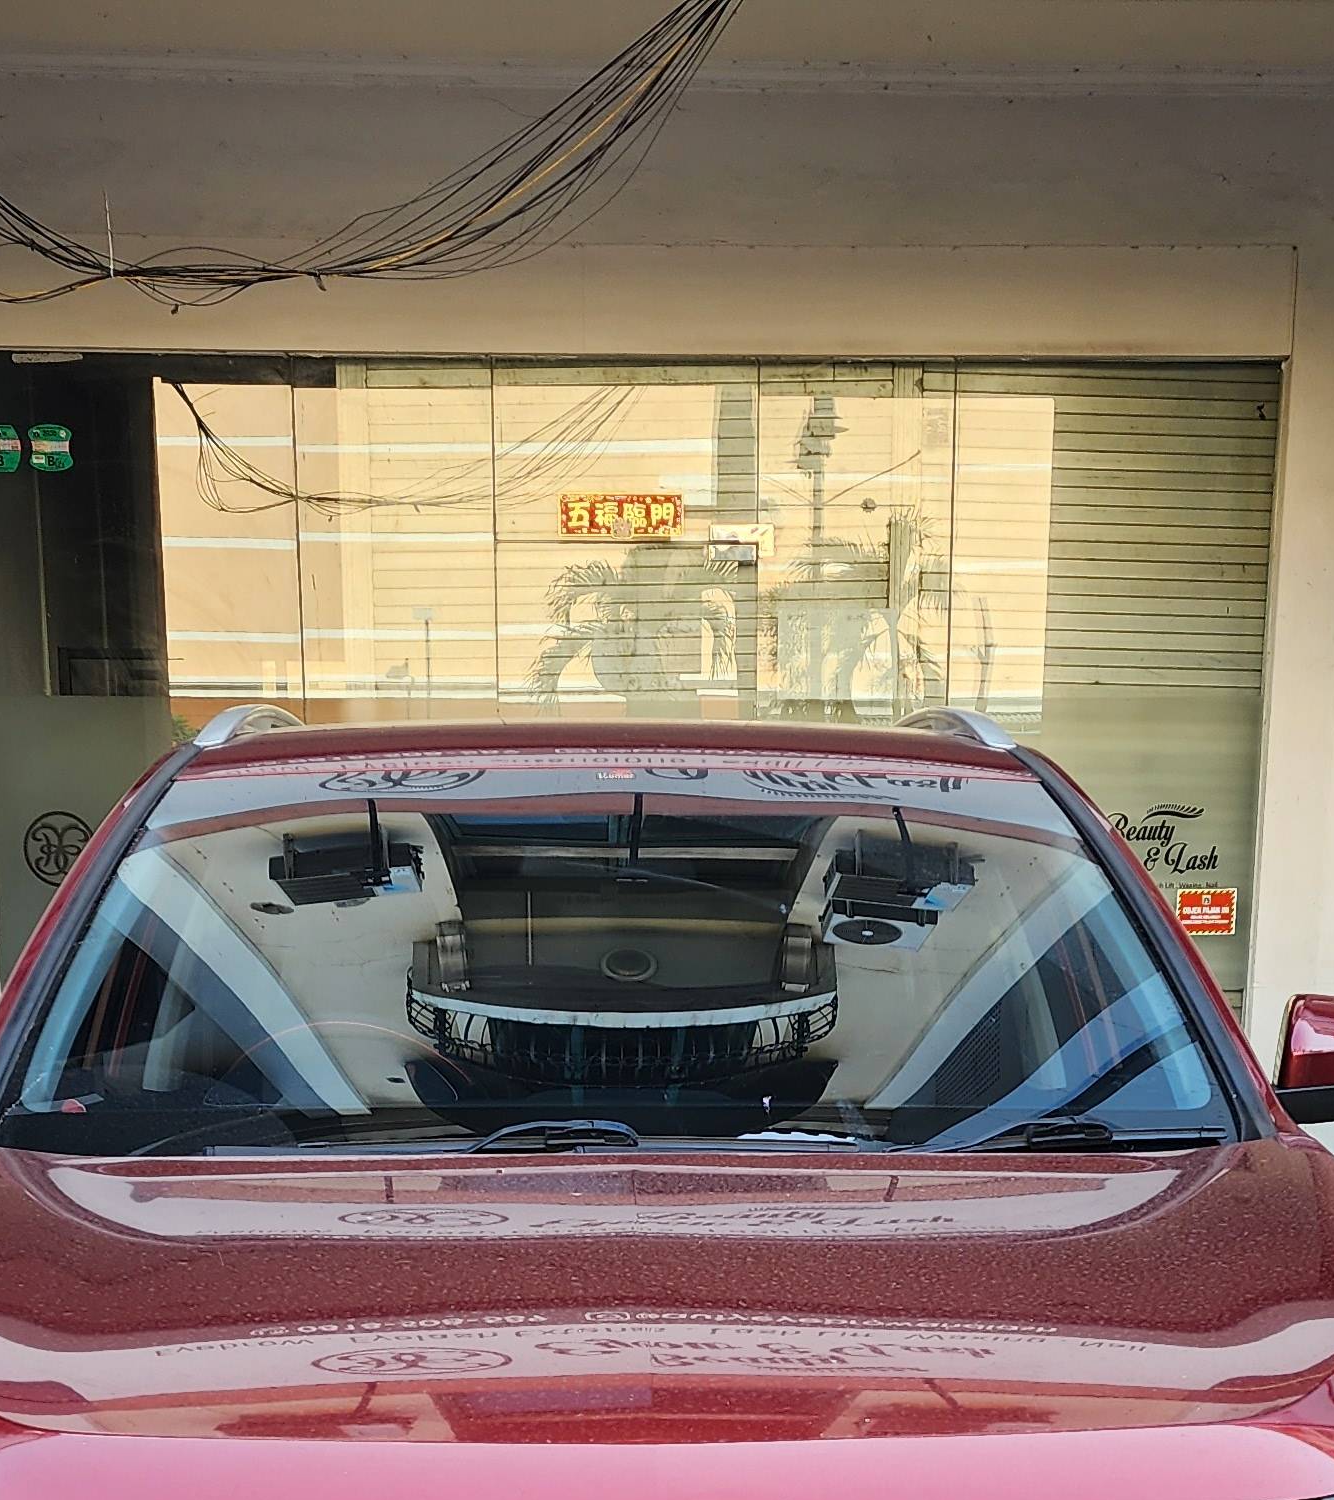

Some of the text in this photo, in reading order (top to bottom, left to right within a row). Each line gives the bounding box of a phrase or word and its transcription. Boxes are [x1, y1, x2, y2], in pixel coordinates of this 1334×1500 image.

[567, 502, 674, 528] 五福臨門
[1143, 842, 1219, 874] & Lash
